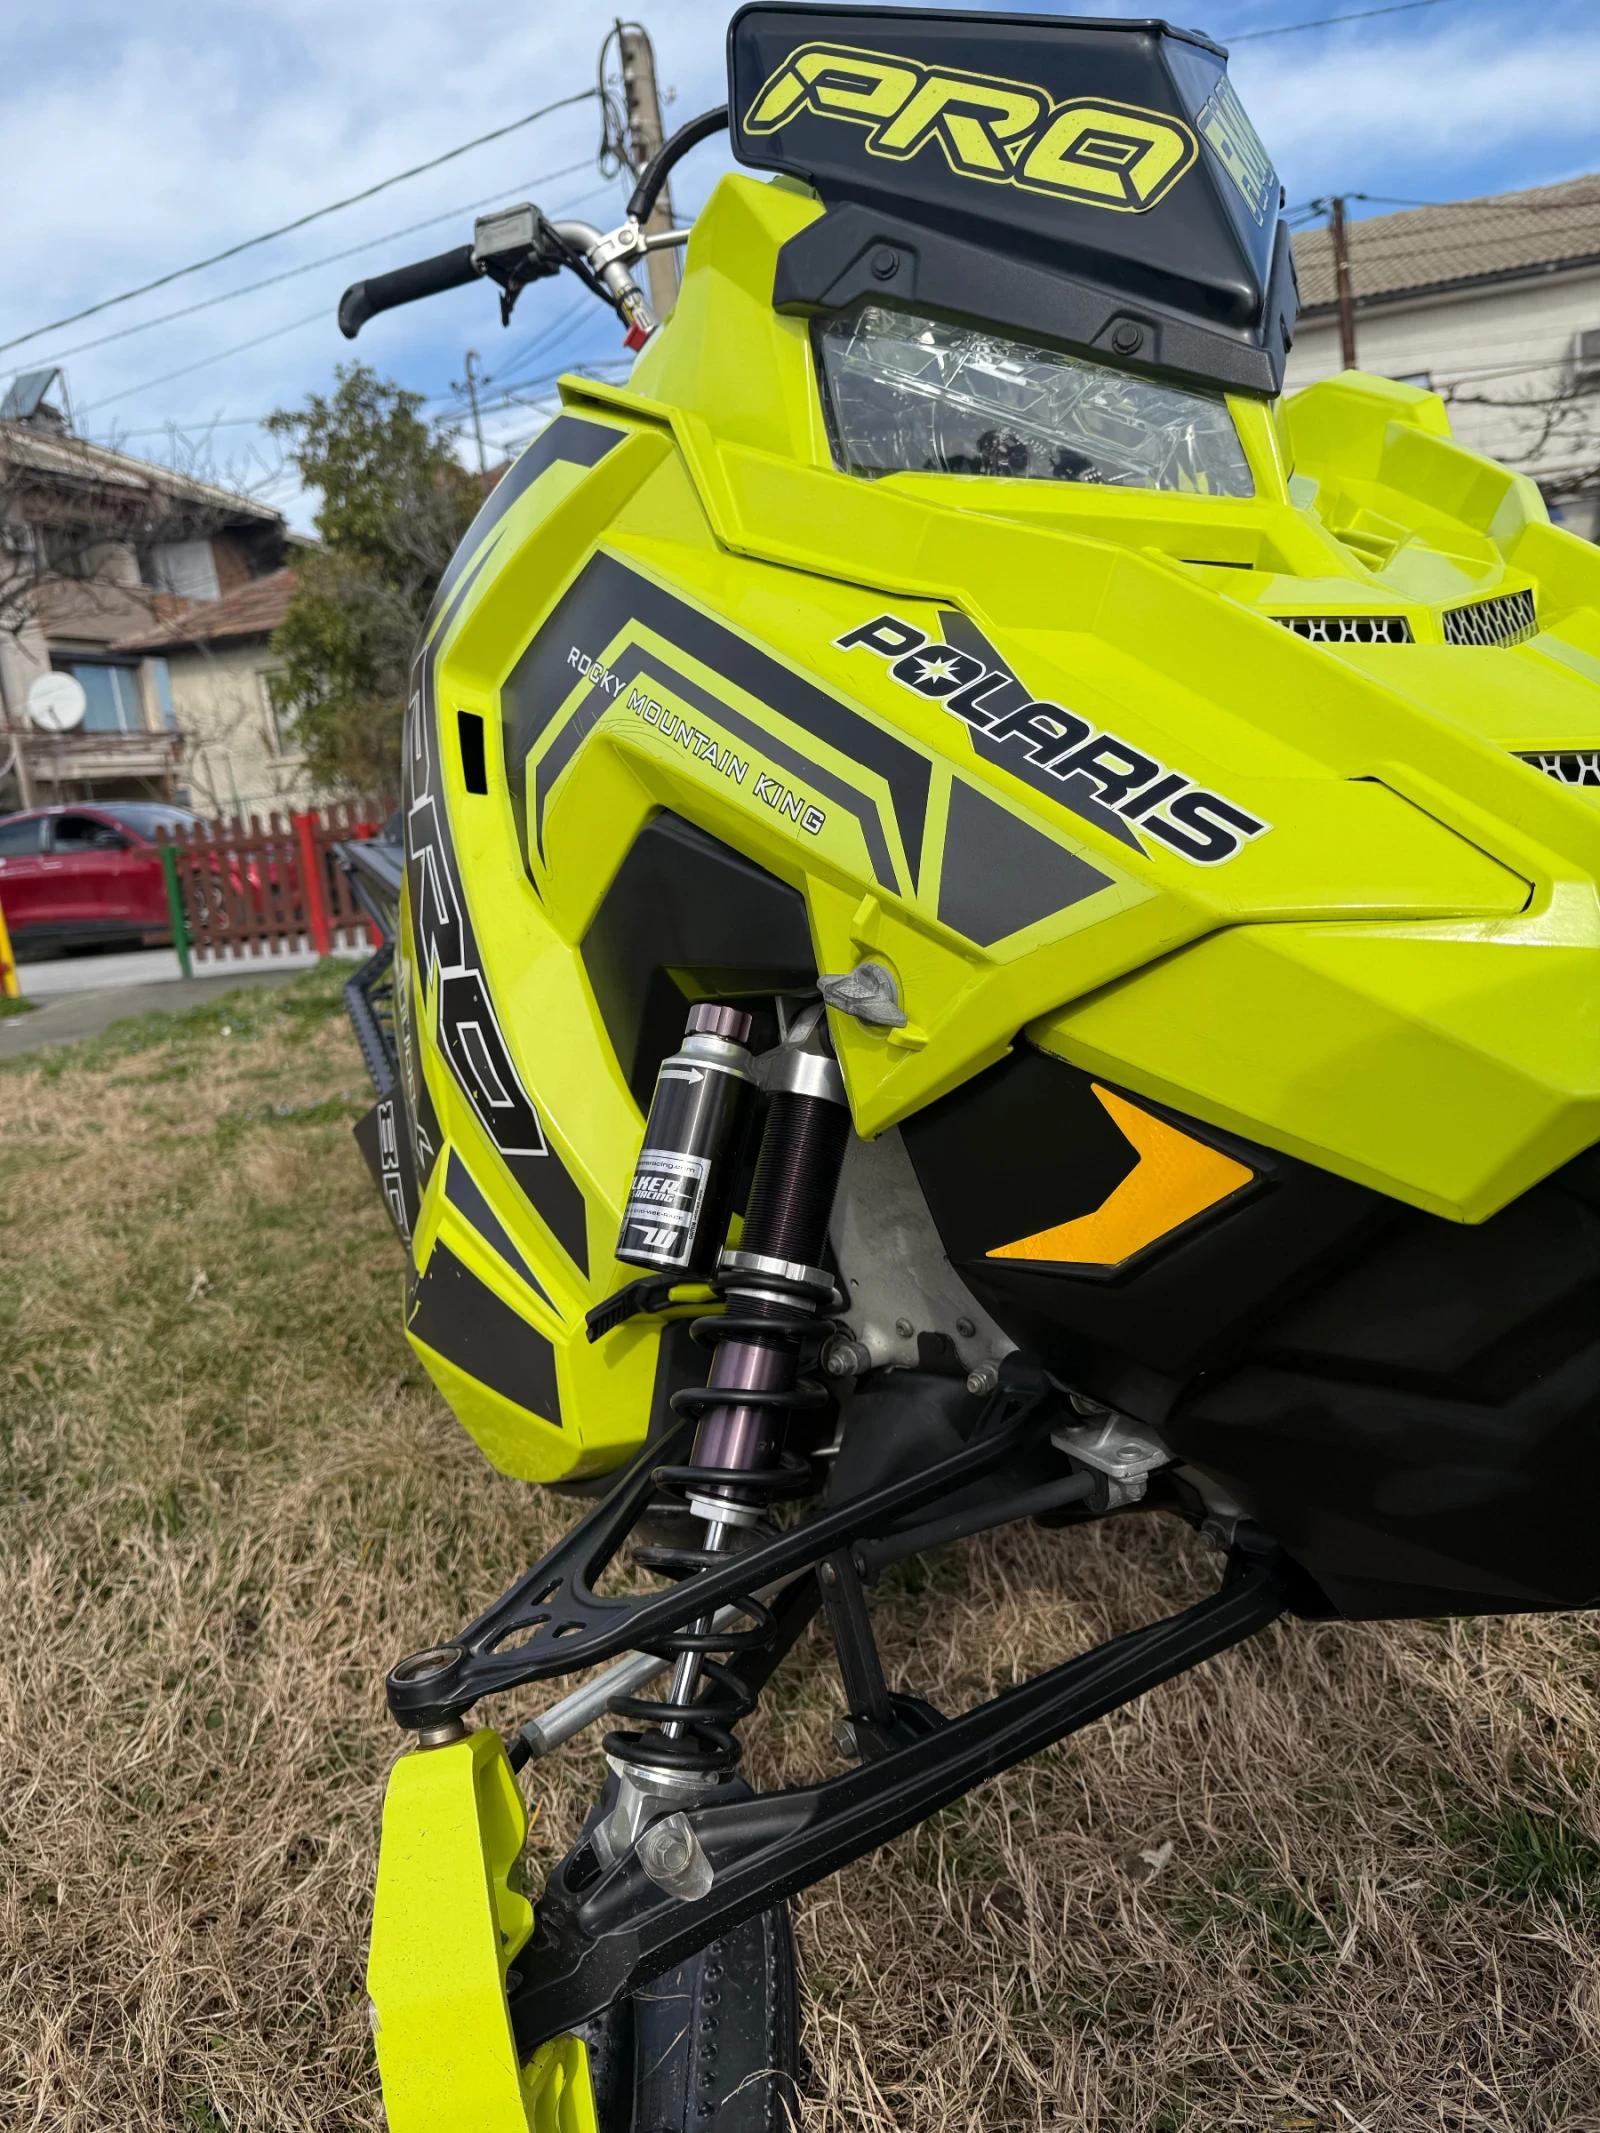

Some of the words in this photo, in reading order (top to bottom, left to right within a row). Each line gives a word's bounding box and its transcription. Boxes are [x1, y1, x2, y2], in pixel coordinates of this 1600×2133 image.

[744, 41, 1199, 213] PRO
[566, 645, 627, 698] ROCKY
[626, 687, 750, 785] MOUNTAIN
[752, 771, 827, 836] KING
[829, 612, 1275, 867] POLARIS
